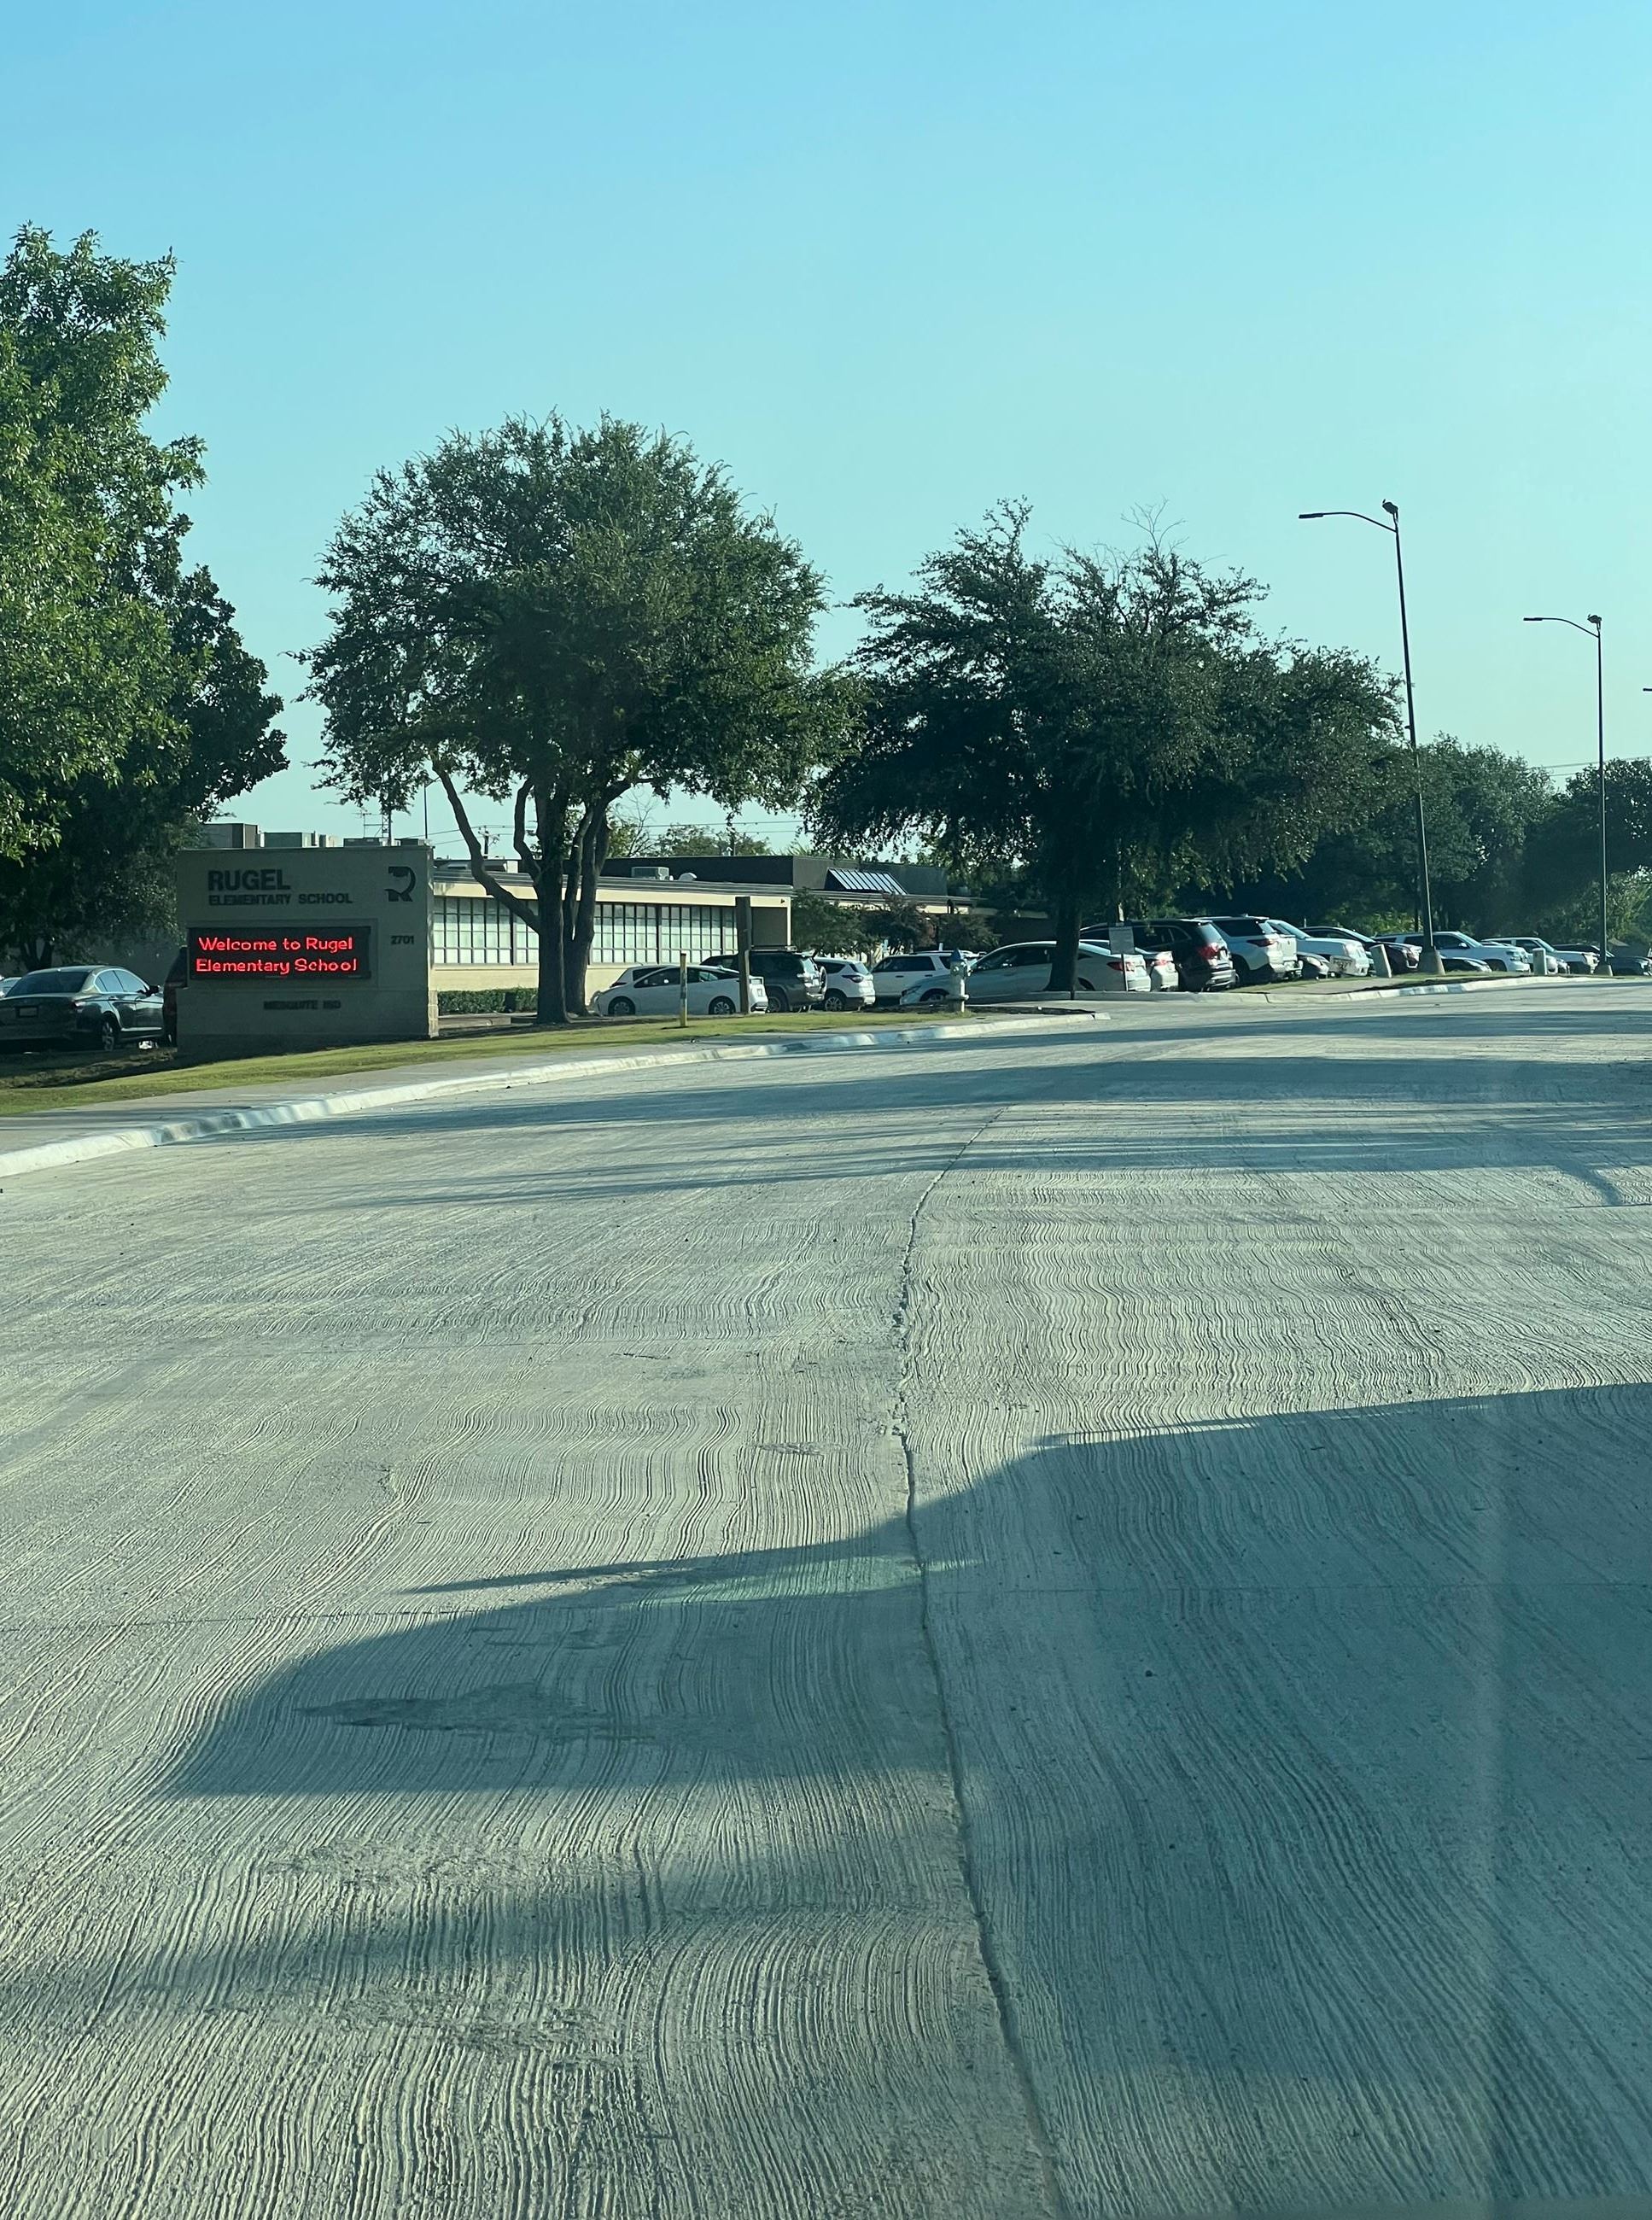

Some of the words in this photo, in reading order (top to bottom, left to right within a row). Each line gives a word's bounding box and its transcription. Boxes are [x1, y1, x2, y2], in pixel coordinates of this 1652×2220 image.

[208, 869, 290, 891] RUGEL
[208, 894, 291, 905] ELEMENTARY
[298, 894, 353, 903] SCHOOL
[198, 937, 277, 950] Welcome
[283, 938, 301, 950] to
[306, 937, 353, 953] Rugel
[391, 935, 414, 944] 2701
[196, 958, 289, 974] Elementary
[294, 958, 357, 972] School
